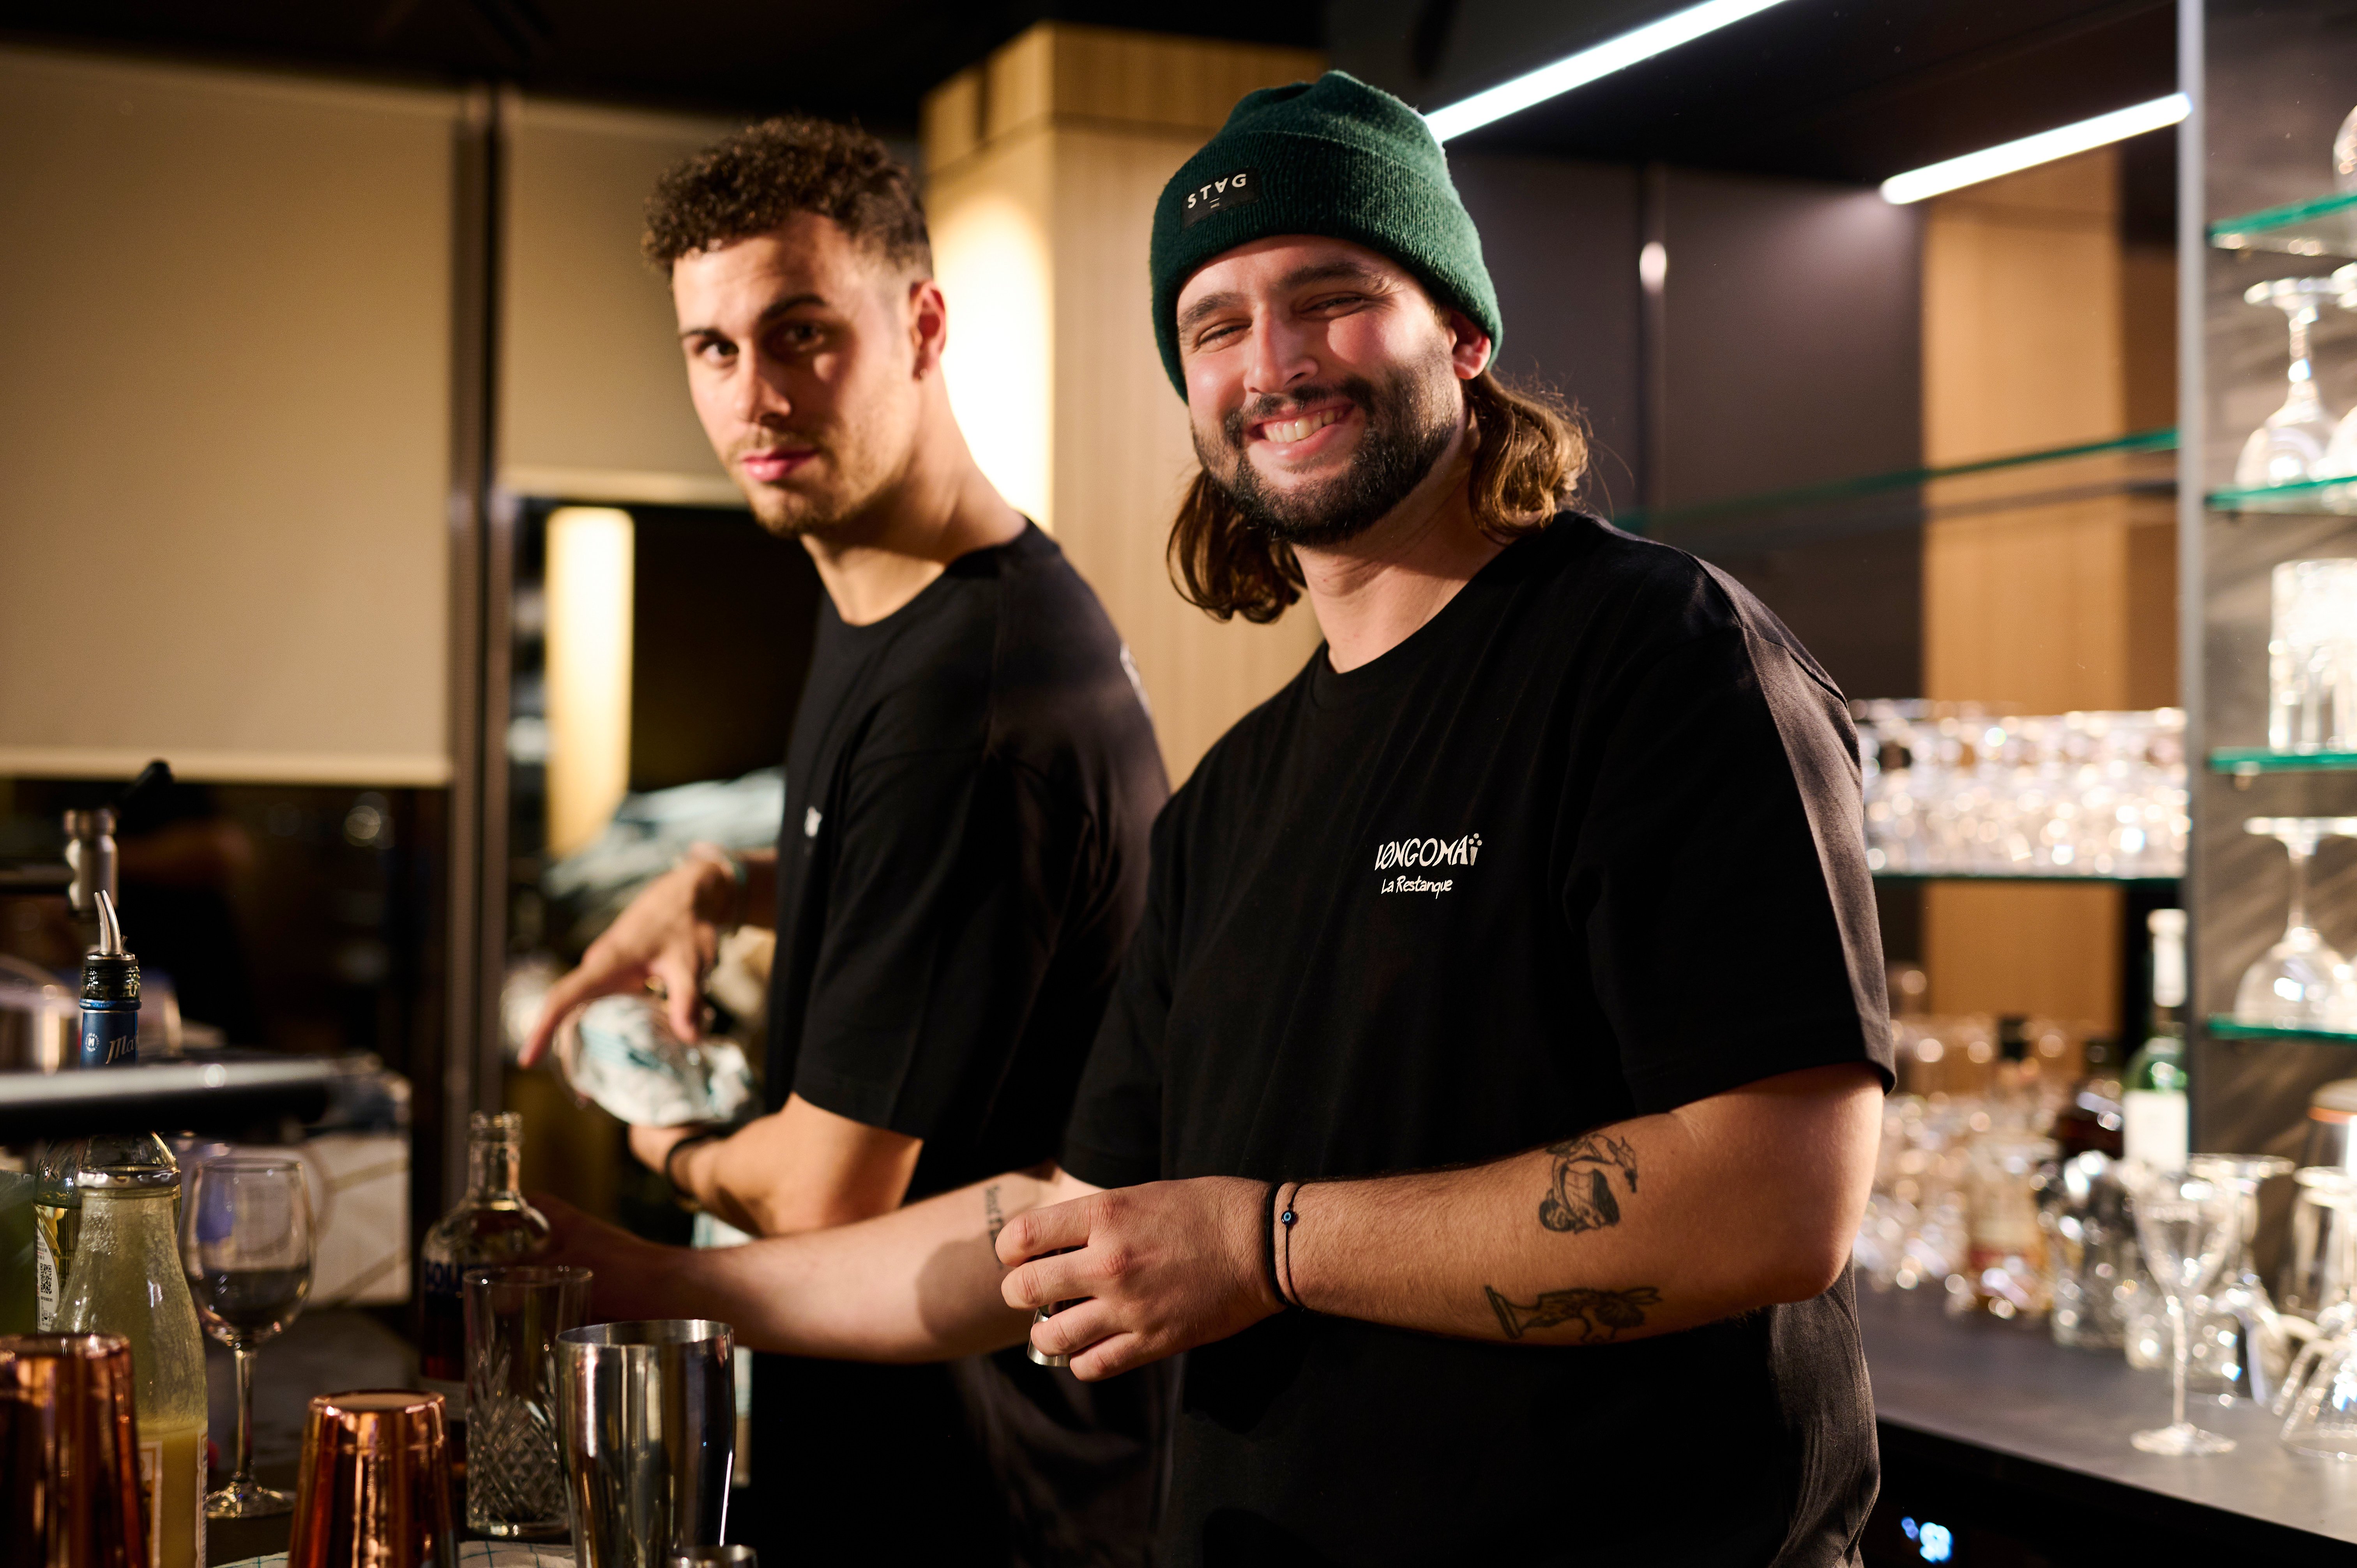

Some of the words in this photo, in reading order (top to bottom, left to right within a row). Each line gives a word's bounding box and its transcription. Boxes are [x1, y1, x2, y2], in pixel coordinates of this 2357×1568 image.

[1187, 173, 1247, 209] STAG
[1381, 878, 1394, 894] La
[1396, 875, 1453, 899] Restanque
